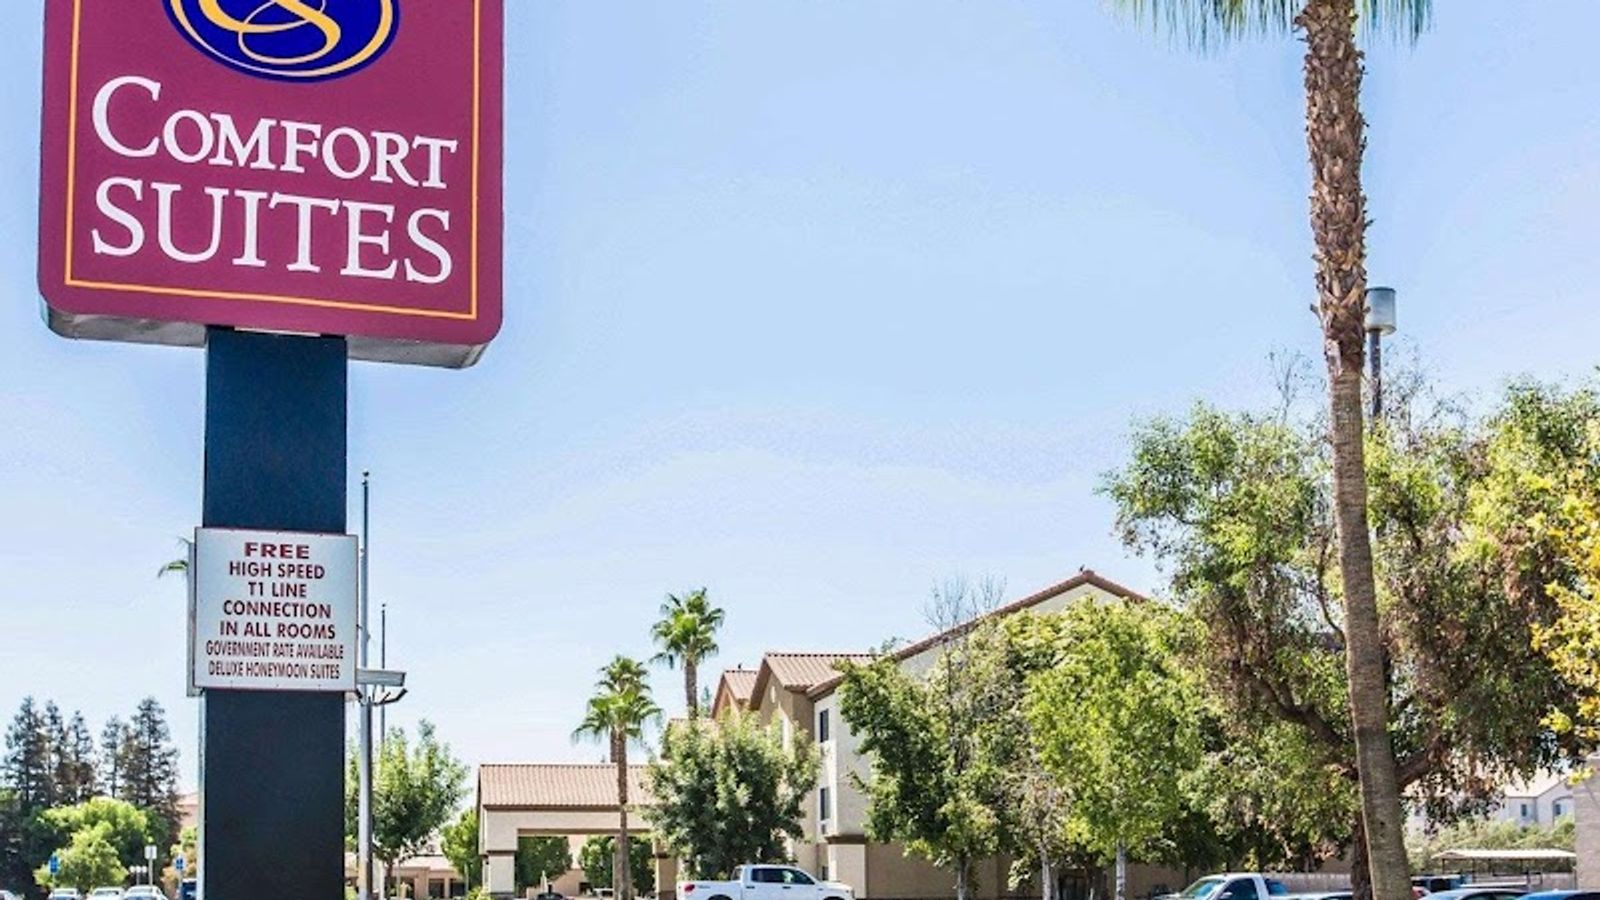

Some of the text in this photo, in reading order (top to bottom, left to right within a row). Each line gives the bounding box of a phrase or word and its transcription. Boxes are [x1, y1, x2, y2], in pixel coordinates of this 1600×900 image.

[91, 177, 453, 284] SUITES
[244, 542, 310, 559] FREE
[229, 561, 325, 579] HIGH SPEED
[248, 582, 307, 598] T1 LINE
[223, 600, 331, 618] CONNECTION
[220, 621, 336, 639] IN ALL ROOMS
[206, 640, 344, 659] GOVERNMENT RATE AVAILABLE
[208, 661, 340, 679] DELUXE HONEYMOON SUITES
